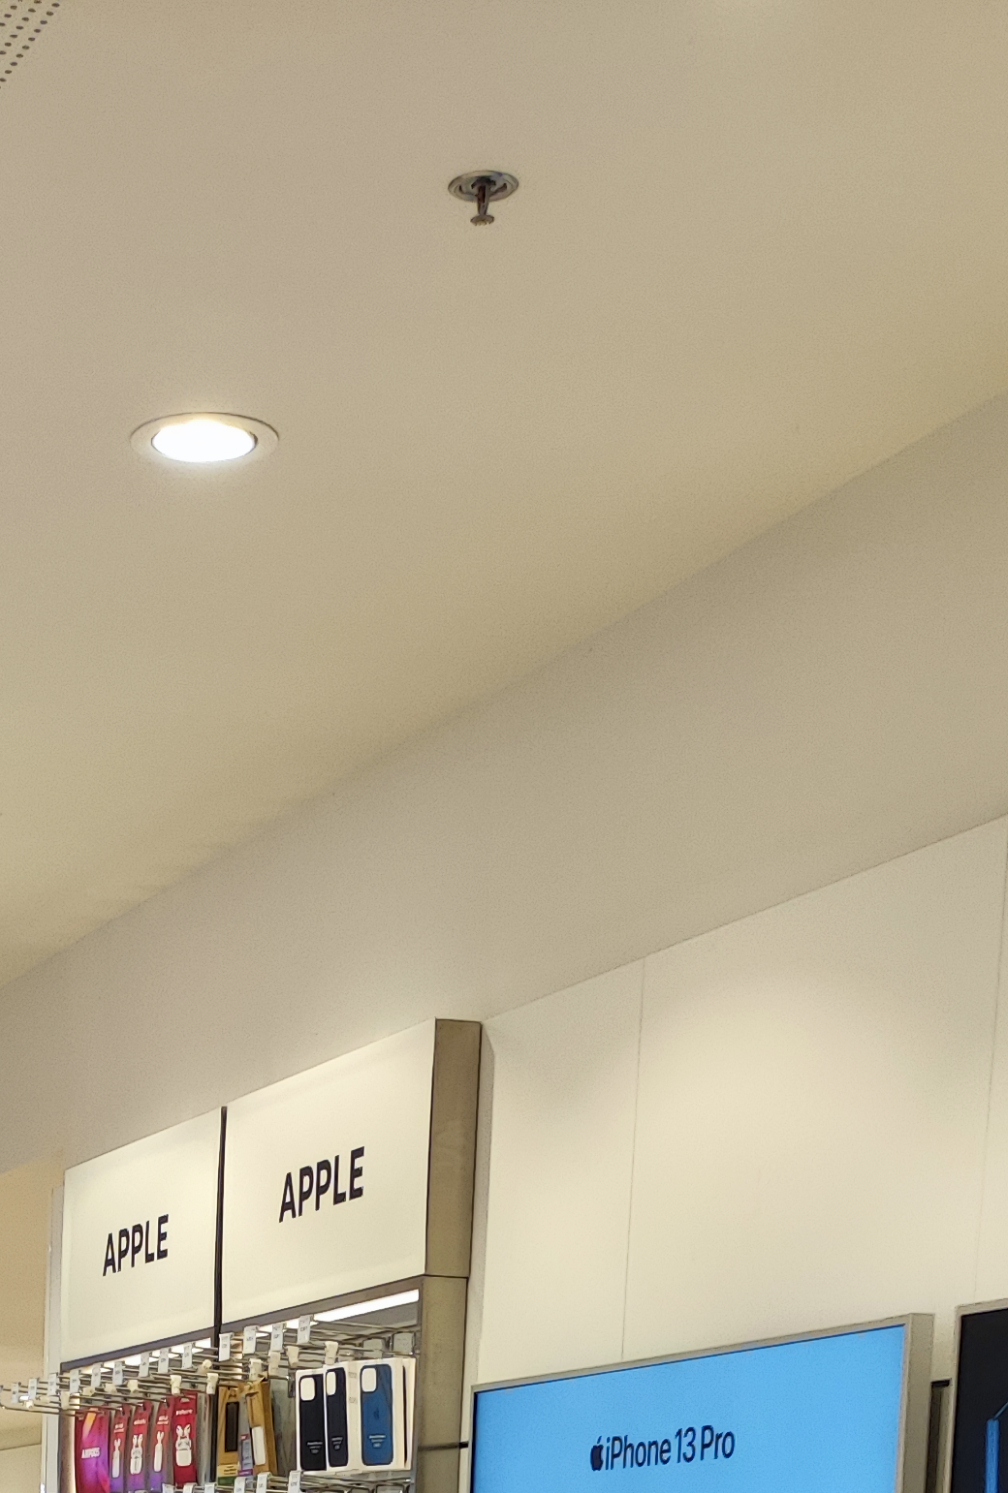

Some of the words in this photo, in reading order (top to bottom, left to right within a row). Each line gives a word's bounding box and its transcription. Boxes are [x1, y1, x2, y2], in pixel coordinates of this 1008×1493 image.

[278, 1146, 365, 1223] APPLE
[103, 1214, 170, 1276] APPLE
[605, 1435, 671, 1470] iPhone
[675, 1426, 696, 1464] 13
[700, 1424, 735, 1461] Pro
